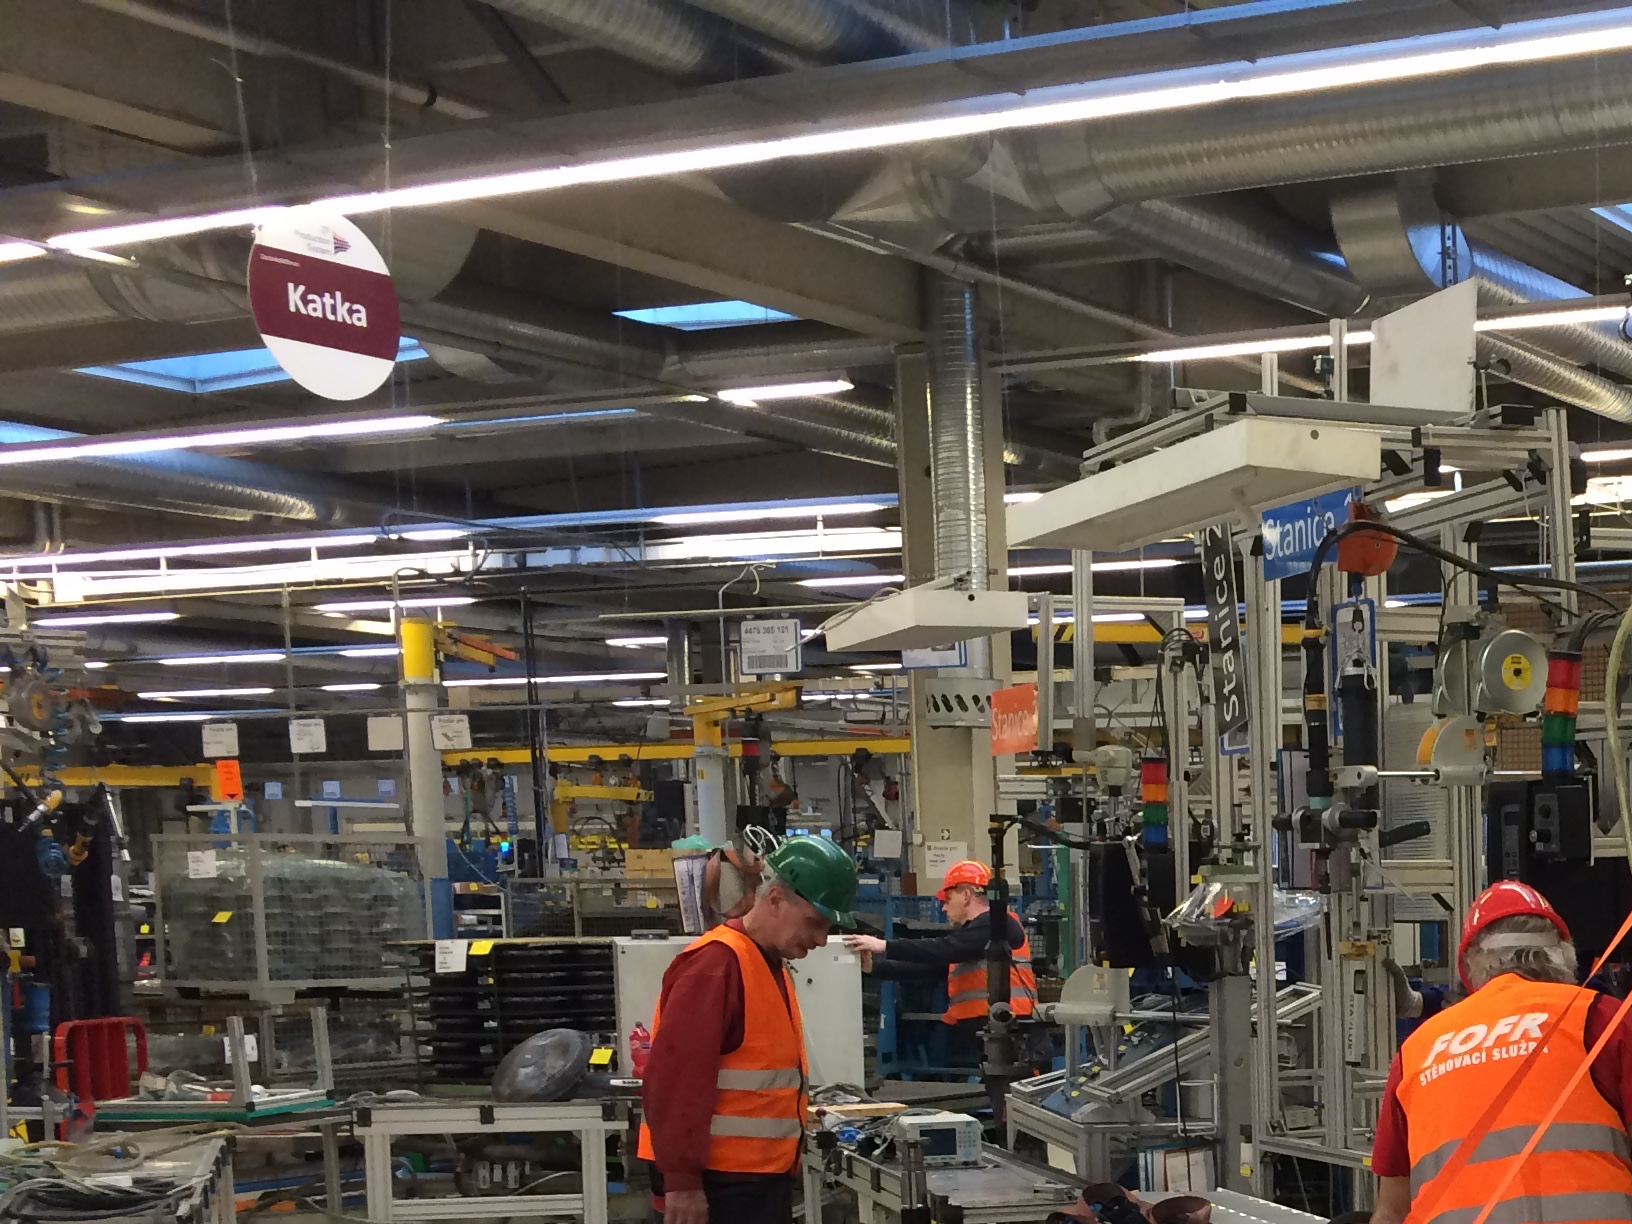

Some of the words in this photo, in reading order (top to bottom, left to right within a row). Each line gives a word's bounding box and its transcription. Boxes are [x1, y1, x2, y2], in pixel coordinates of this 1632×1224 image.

[287, 282, 368, 328] Katka
[1265, 506, 1335, 560] Stanice
[1213, 553, 1239, 723] Stanice
[1421, 1012, 1549, 1069] FOFR
